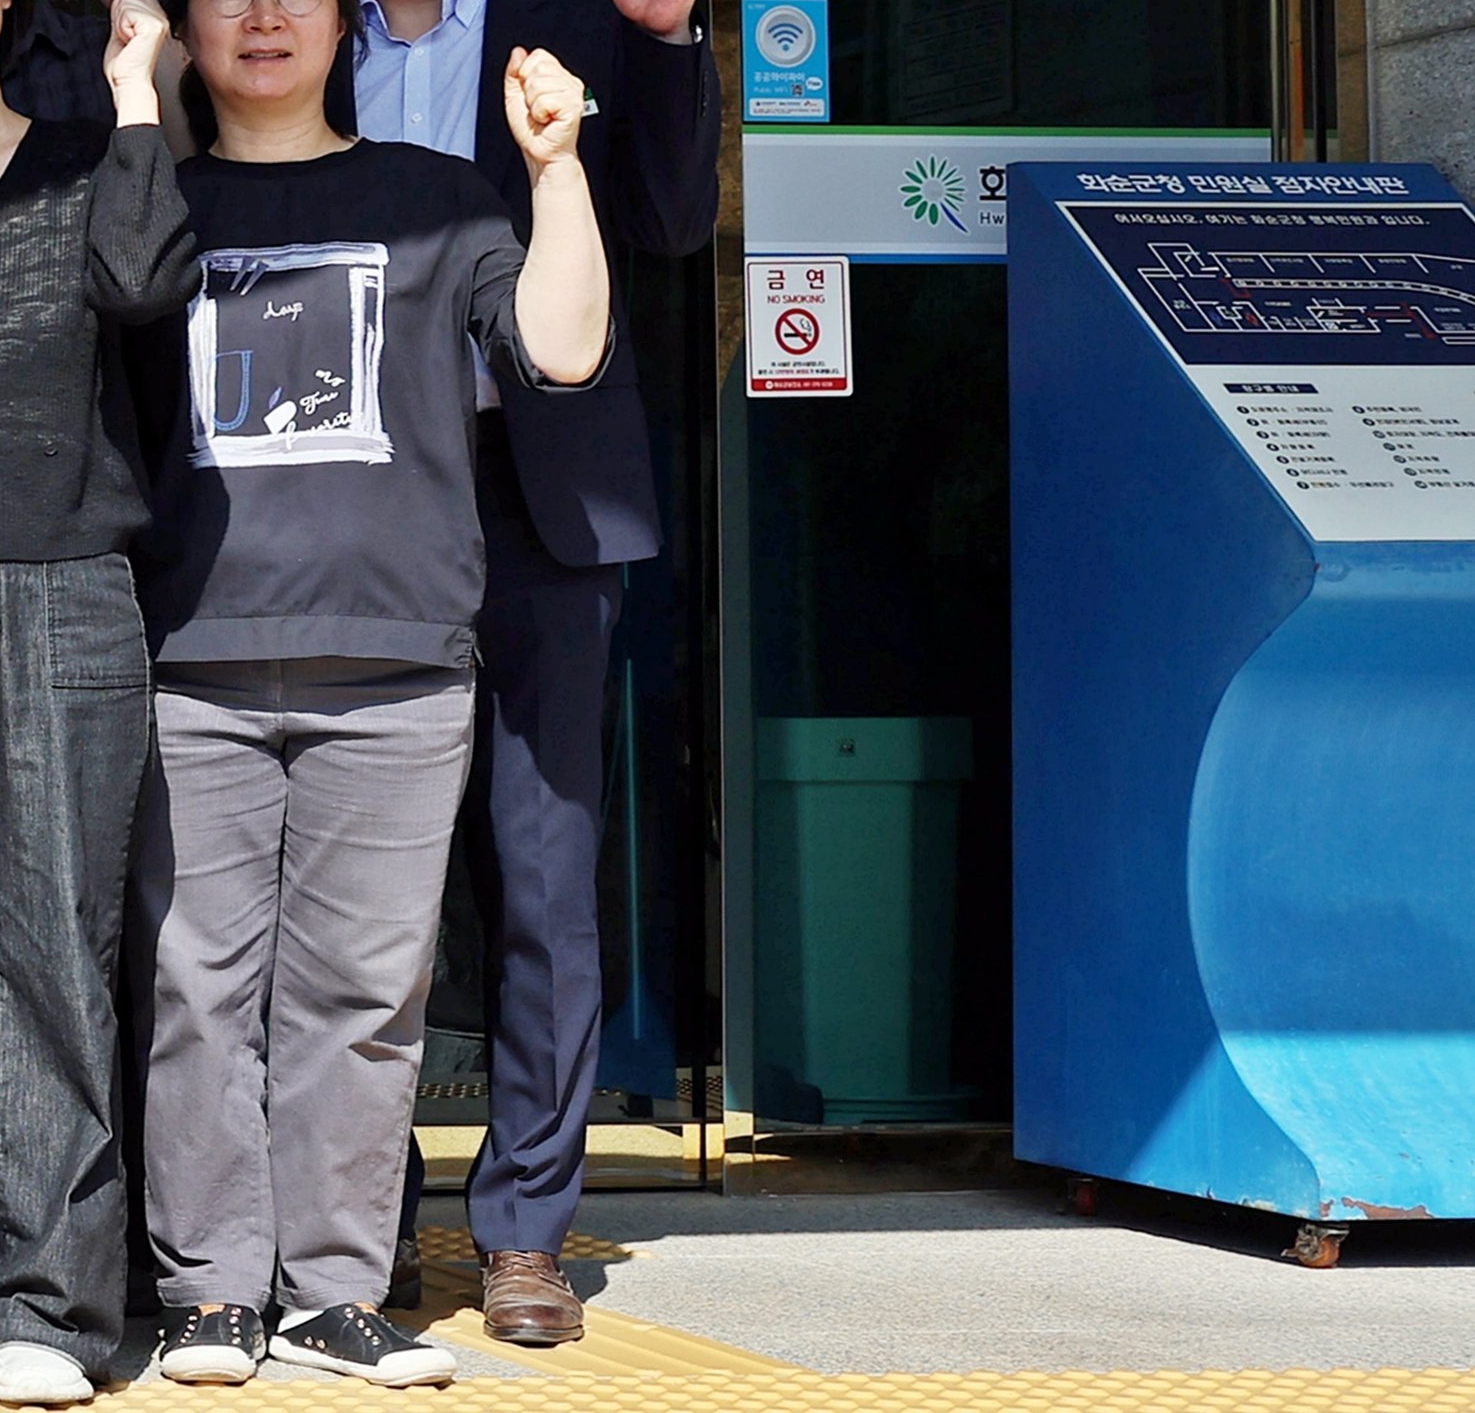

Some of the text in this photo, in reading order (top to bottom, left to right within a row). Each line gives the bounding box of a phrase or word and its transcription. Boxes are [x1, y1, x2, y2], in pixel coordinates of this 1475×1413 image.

[1077, 174, 1409, 194] 화순군청 민원실 점자안내판
[767, 295, 825, 304] NO SMOKING
